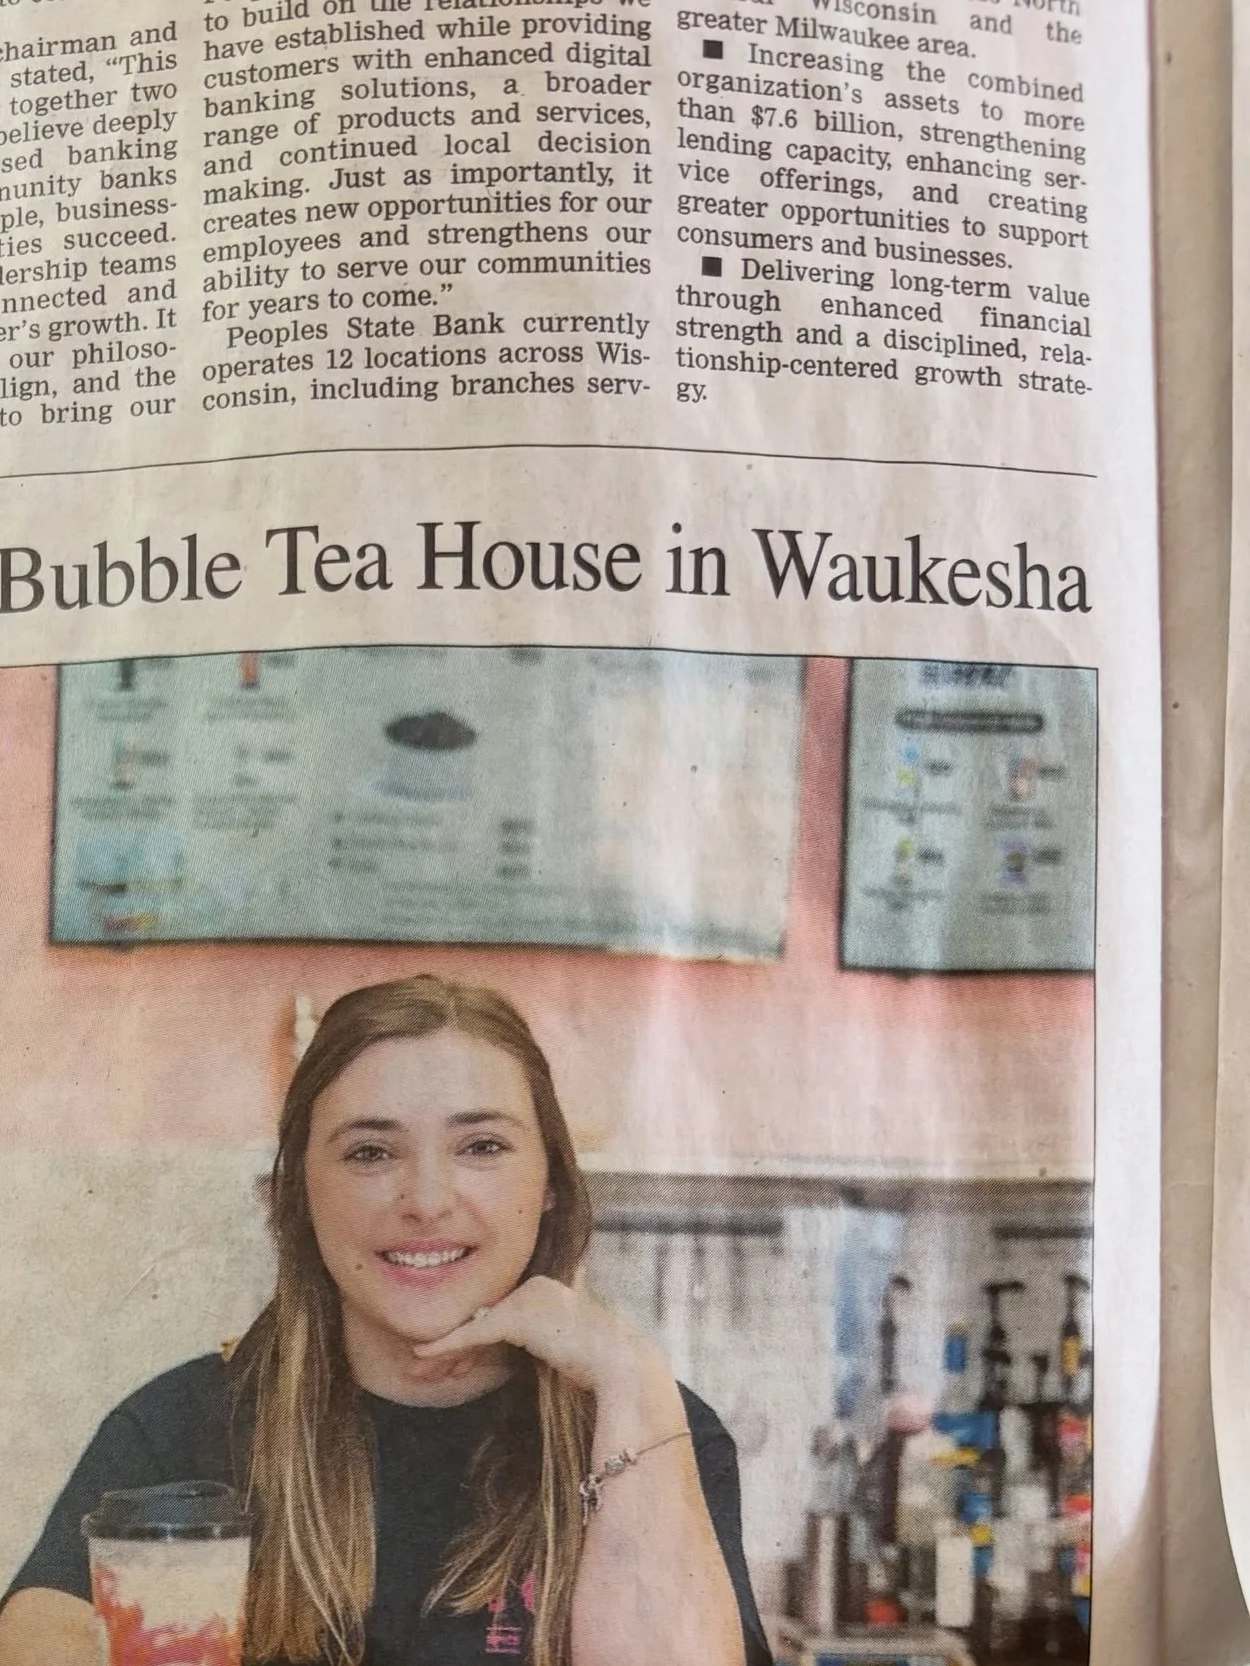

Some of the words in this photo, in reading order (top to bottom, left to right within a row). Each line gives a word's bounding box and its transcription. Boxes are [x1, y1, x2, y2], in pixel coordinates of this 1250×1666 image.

[676, 7, 768, 38] greater
[774, 14, 910, 52] Milwaukee
[918, 32, 975, 62] area.
[203, 300, 239, 322] for
[248, 294, 319, 320] years
[328, 288, 353, 309] to
[742, 256, 877, 294] Delivering
[890, 268, 1012, 298] long-term
[1028, 281, 1090, 310] value
[677, 382, 706, 403] gy.
[266, 525, 393, 595] Tea
[417, 521, 642, 592] House
[666, 523, 730, 596] in
[752, 529, 1092, 613] Waukesha
